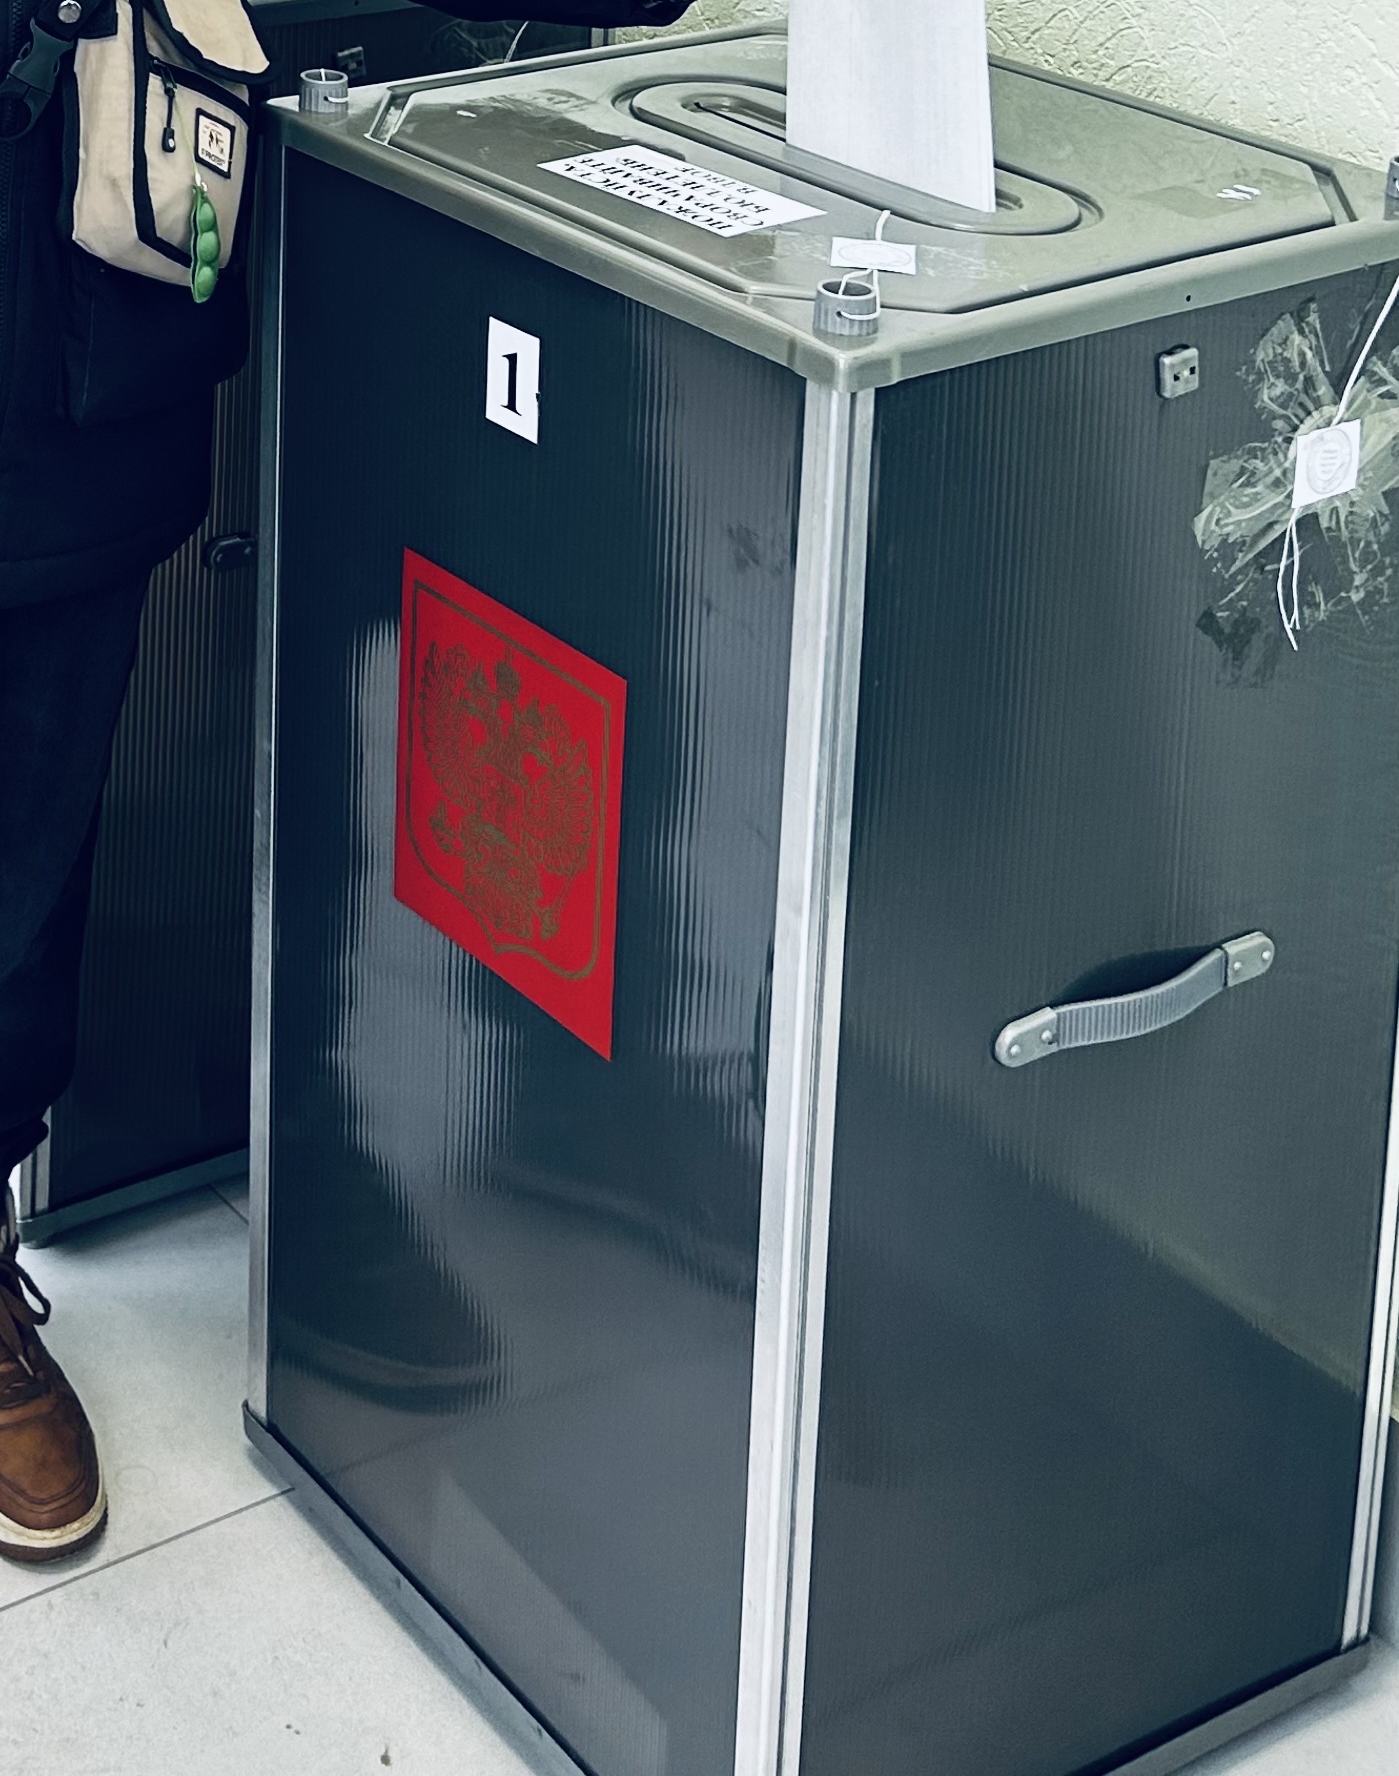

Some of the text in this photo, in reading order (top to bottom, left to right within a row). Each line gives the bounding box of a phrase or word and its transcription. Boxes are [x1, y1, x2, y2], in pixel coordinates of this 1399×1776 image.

[574, 156, 765, 227] СВОРАЧИВАЙТЕ
[615, 157, 771, 214] БЮЛЛЕТЕНЬ
[500, 352, 522, 417] 1
